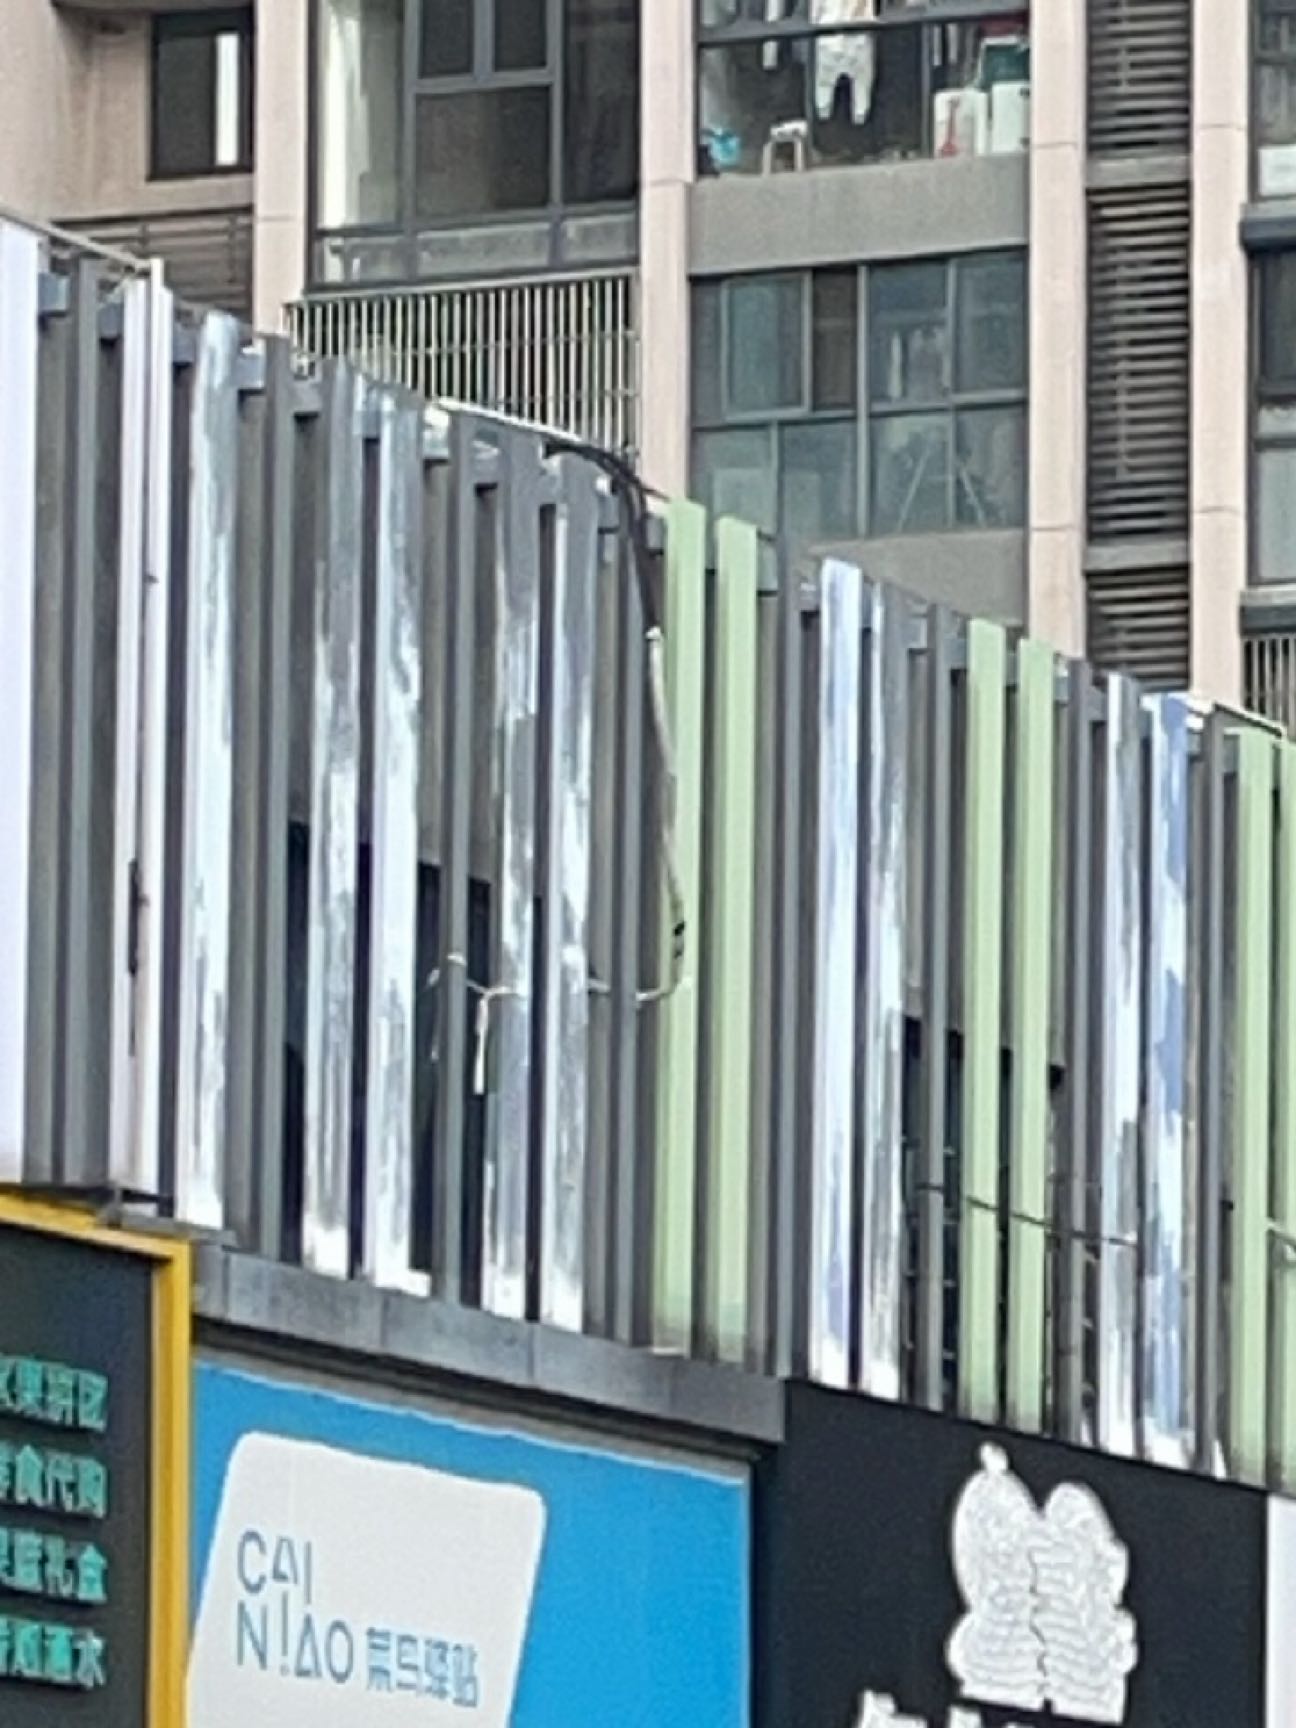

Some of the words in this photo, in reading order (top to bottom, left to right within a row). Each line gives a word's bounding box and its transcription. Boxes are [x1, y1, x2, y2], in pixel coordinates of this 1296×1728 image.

[237, 1530, 312, 1605] CAI
[366, 1626, 478, 1708] 菜鸟驿站
